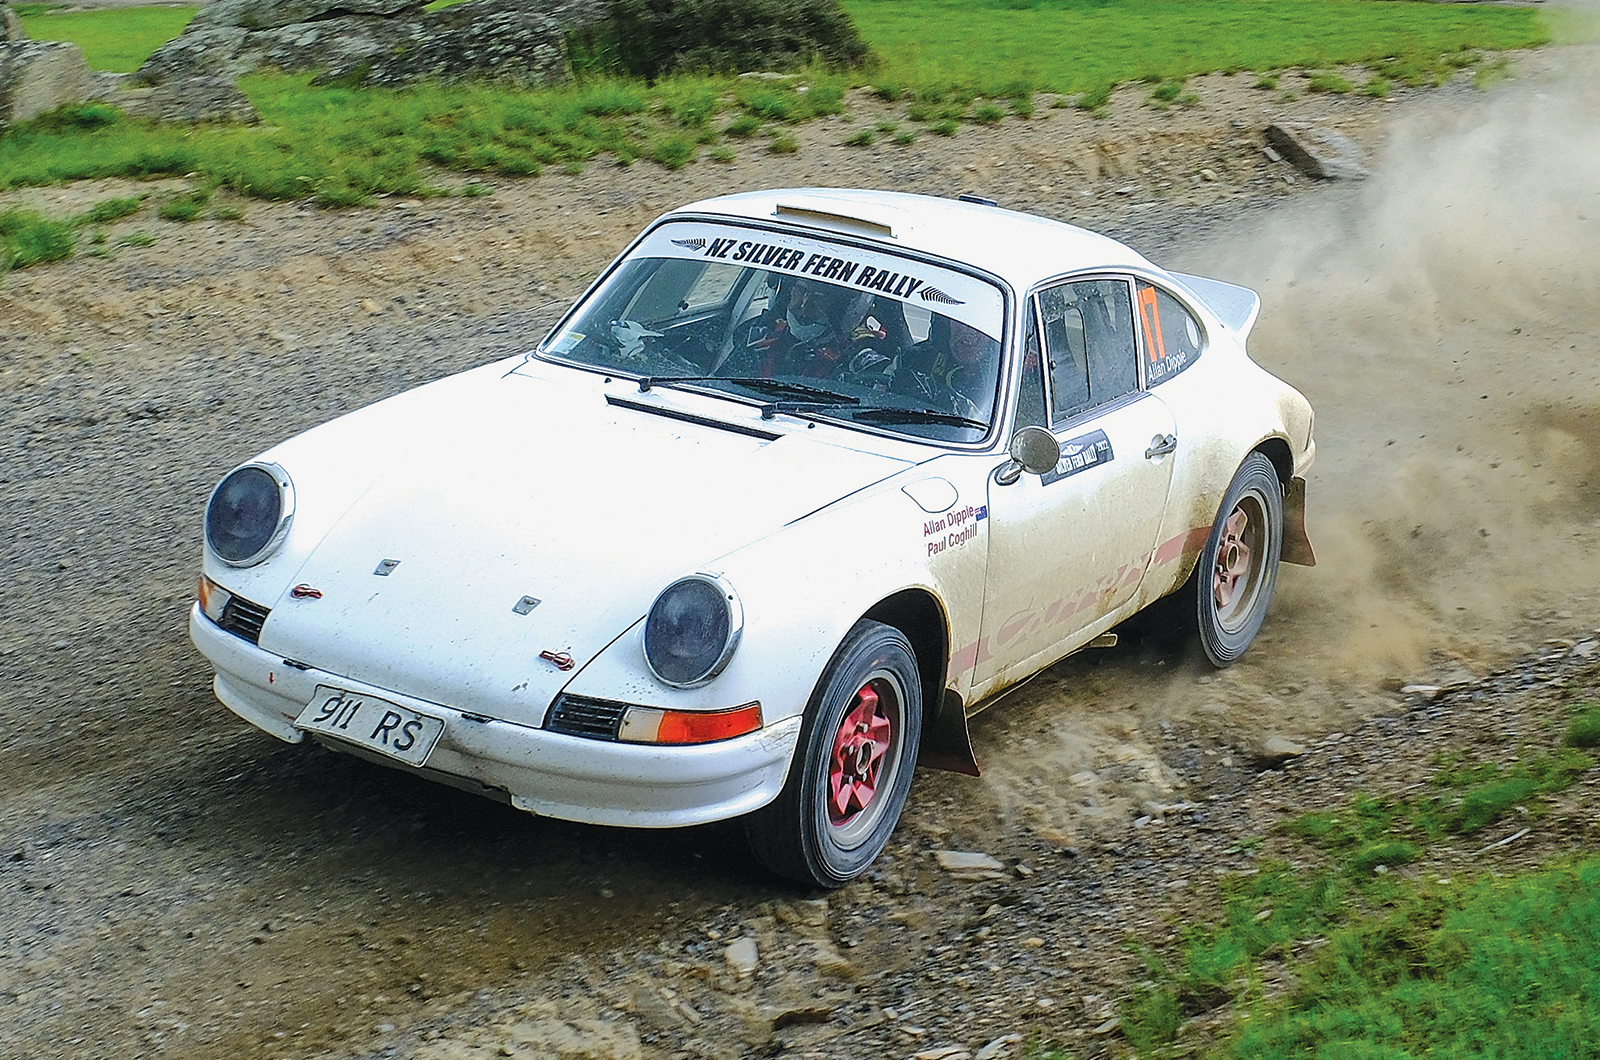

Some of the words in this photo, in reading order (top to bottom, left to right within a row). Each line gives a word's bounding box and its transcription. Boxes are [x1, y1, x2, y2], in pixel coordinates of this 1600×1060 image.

[704, 237, 736, 259] NZ
[733, 241, 804, 272] SILVER
[804, 253, 858, 283] FERN
[855, 261, 923, 299] RALLY
[1137, 286, 1165, 363] 17
[1148, 361, 1167, 382] Allan
[1165, 348, 1187, 373] Dipple
[1071, 452, 1086, 470] FERN
[1082, 443, 1098, 465] RALLY
[924, 520, 946, 538] Allan
[947, 505, 975, 527] Dipple
[928, 536, 947, 557] Paul
[949, 522, 978, 547] Coghill
[313, 696, 363, 730] 911
[370, 709, 423, 751] RS
